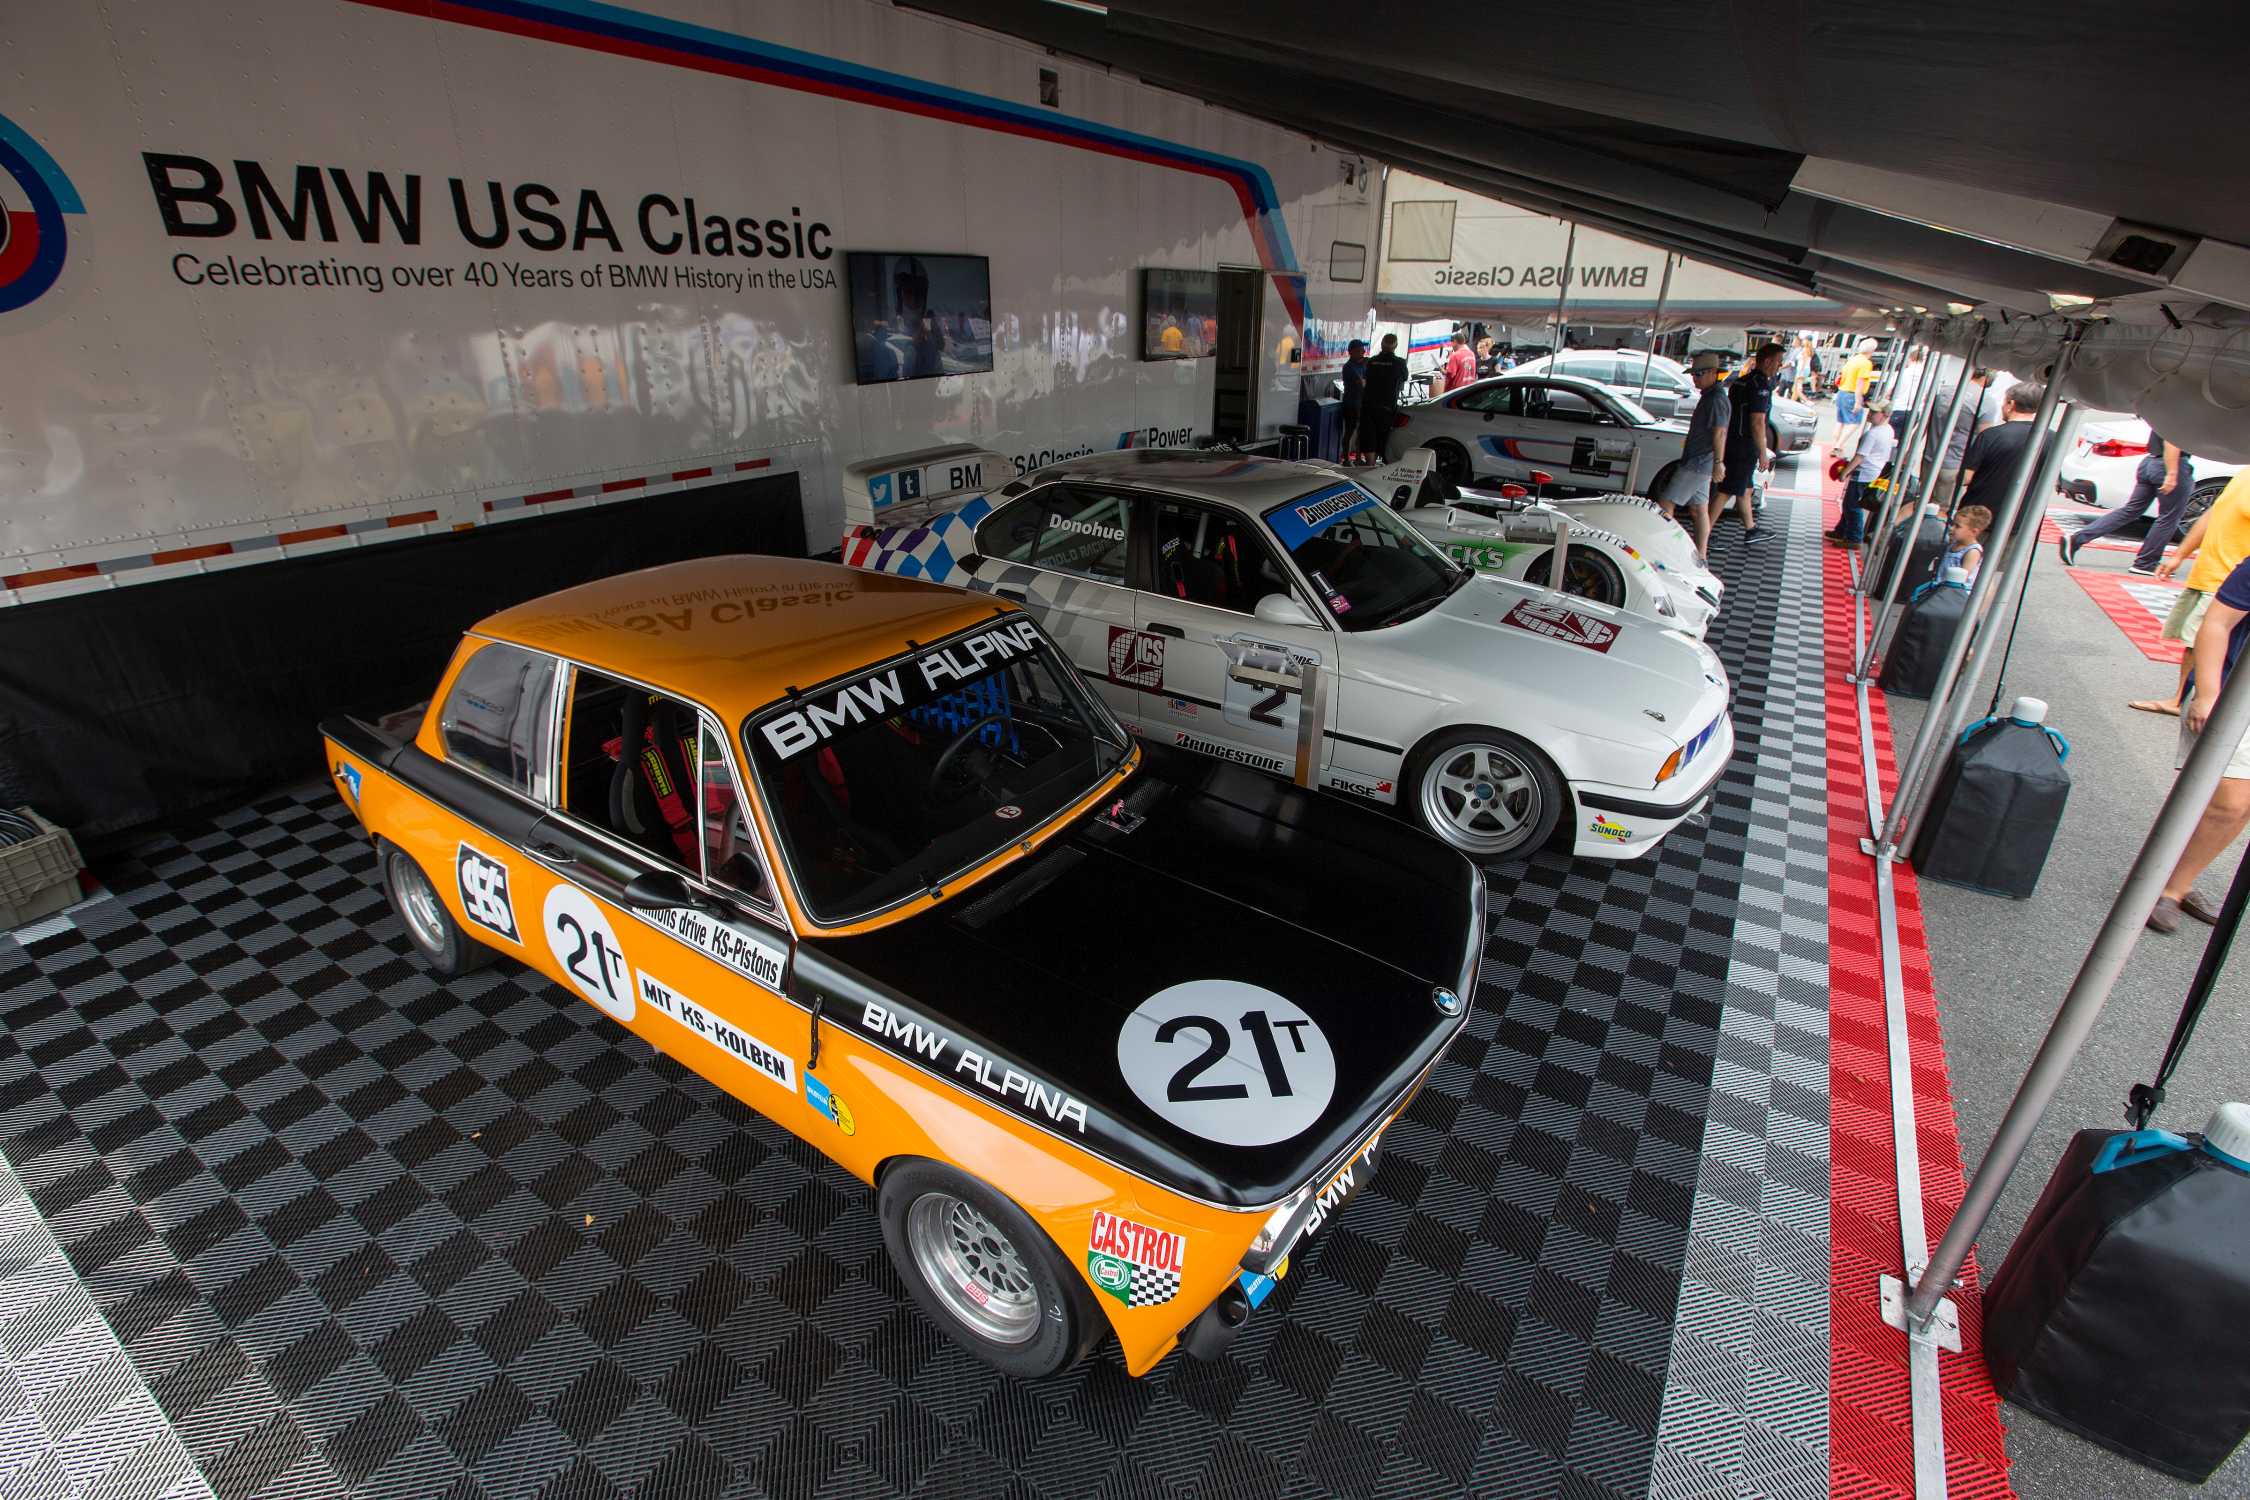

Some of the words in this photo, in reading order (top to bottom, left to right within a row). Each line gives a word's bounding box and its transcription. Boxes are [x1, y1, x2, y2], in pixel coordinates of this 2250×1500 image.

[141, 151, 421, 246] BMW
[448, 177, 624, 252] USA
[637, 193, 833, 260] Classic
[172, 253, 385, 293] Celebrating
[392, 265, 454, 288] over
[464, 261, 499, 288] 40
[502, 262, 574, 289] Years
[580, 263, 603, 288] of
[609, 264, 668, 288] BMW
[675, 265, 743, 294] History
[747, 266, 765, 289] in
[768, 267, 797, 289] the
[801, 268, 838, 289] USA
[1149, 426, 1193, 449] Power
[1049, 513, 1126, 542] Donohue
[1296, 489, 1367, 526] BRIDGESTONE
[1137, 634, 1164, 666] ICS
[760, 669, 905, 761] BMW
[917, 620, 1048, 691] ALPINA
[1175, 731, 1285, 772] BRIDGESTONE
[1331, 778, 1376, 799] FIKSE
[1590, 822, 1633, 839] SUNOCO
[678, 911, 707, 946] drive
[711, 925, 779, 984] KS-Pistons
[642, 979, 673, 1013] MIT
[680, 1002, 786, 1082] KS-KOLBEN
[861, 1000, 949, 1061] BMW
[955, 1049, 1088, 1133] ALPINA
[1090, 1211, 1183, 1274] CASTROL
